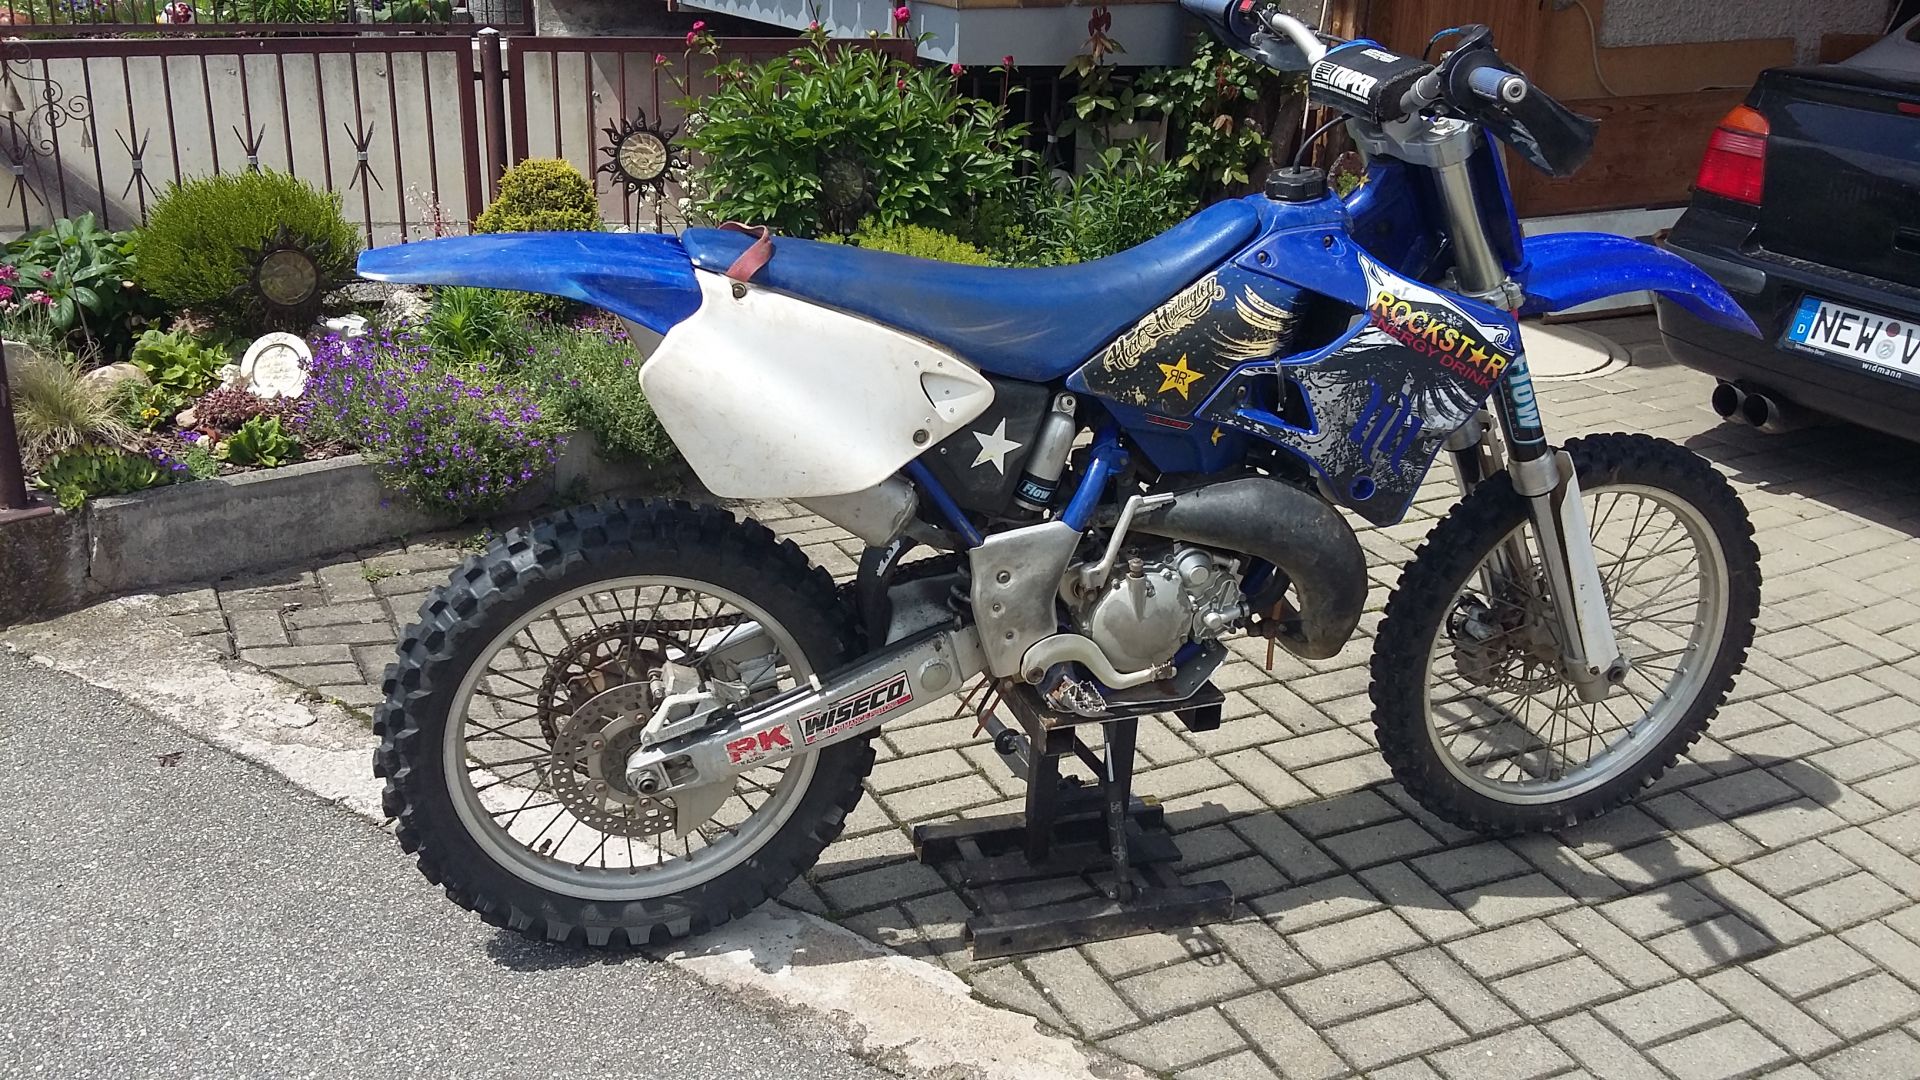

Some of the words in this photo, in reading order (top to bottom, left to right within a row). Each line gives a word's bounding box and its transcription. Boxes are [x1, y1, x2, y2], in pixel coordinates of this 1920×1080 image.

[1314, 62, 1335, 82] PRO
[1330, 65, 1378, 99] TAPER
[1370, 311, 1440, 358] ENERGY
[1440, 354, 1494, 389] DRINK
[1796, 323, 1807, 334] D
[1811, 306, 1884, 354] NEW
[1861, 362, 1903, 379] widmann
[805, 679, 906, 737] WISECO
